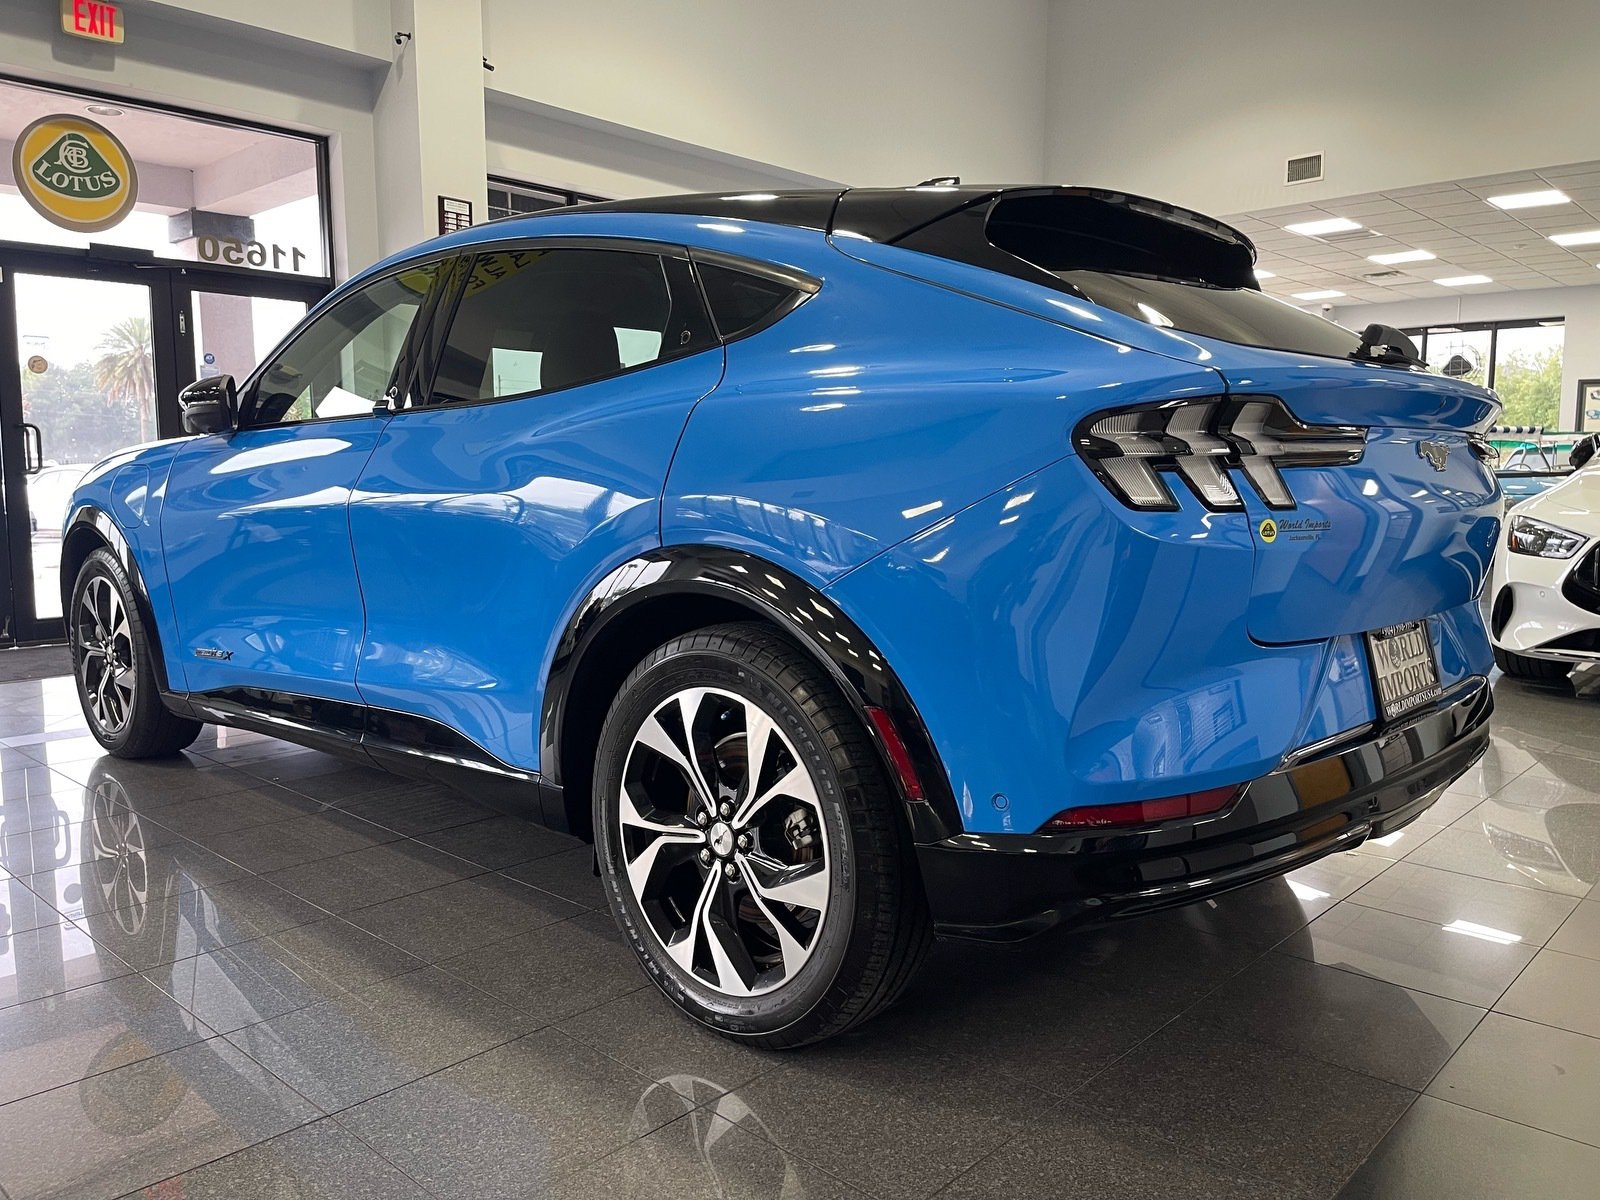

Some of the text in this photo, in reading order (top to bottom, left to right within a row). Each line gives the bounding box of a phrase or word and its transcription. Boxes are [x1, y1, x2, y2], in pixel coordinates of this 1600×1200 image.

[73, 0, 116, 38] EXIT
[34, 159, 117, 192] LOTUS
[1279, 518, 1331, 531] World Imports
[1374, 630, 1426, 669] WORLD
[1379, 659, 1435, 701] IMPORTS
